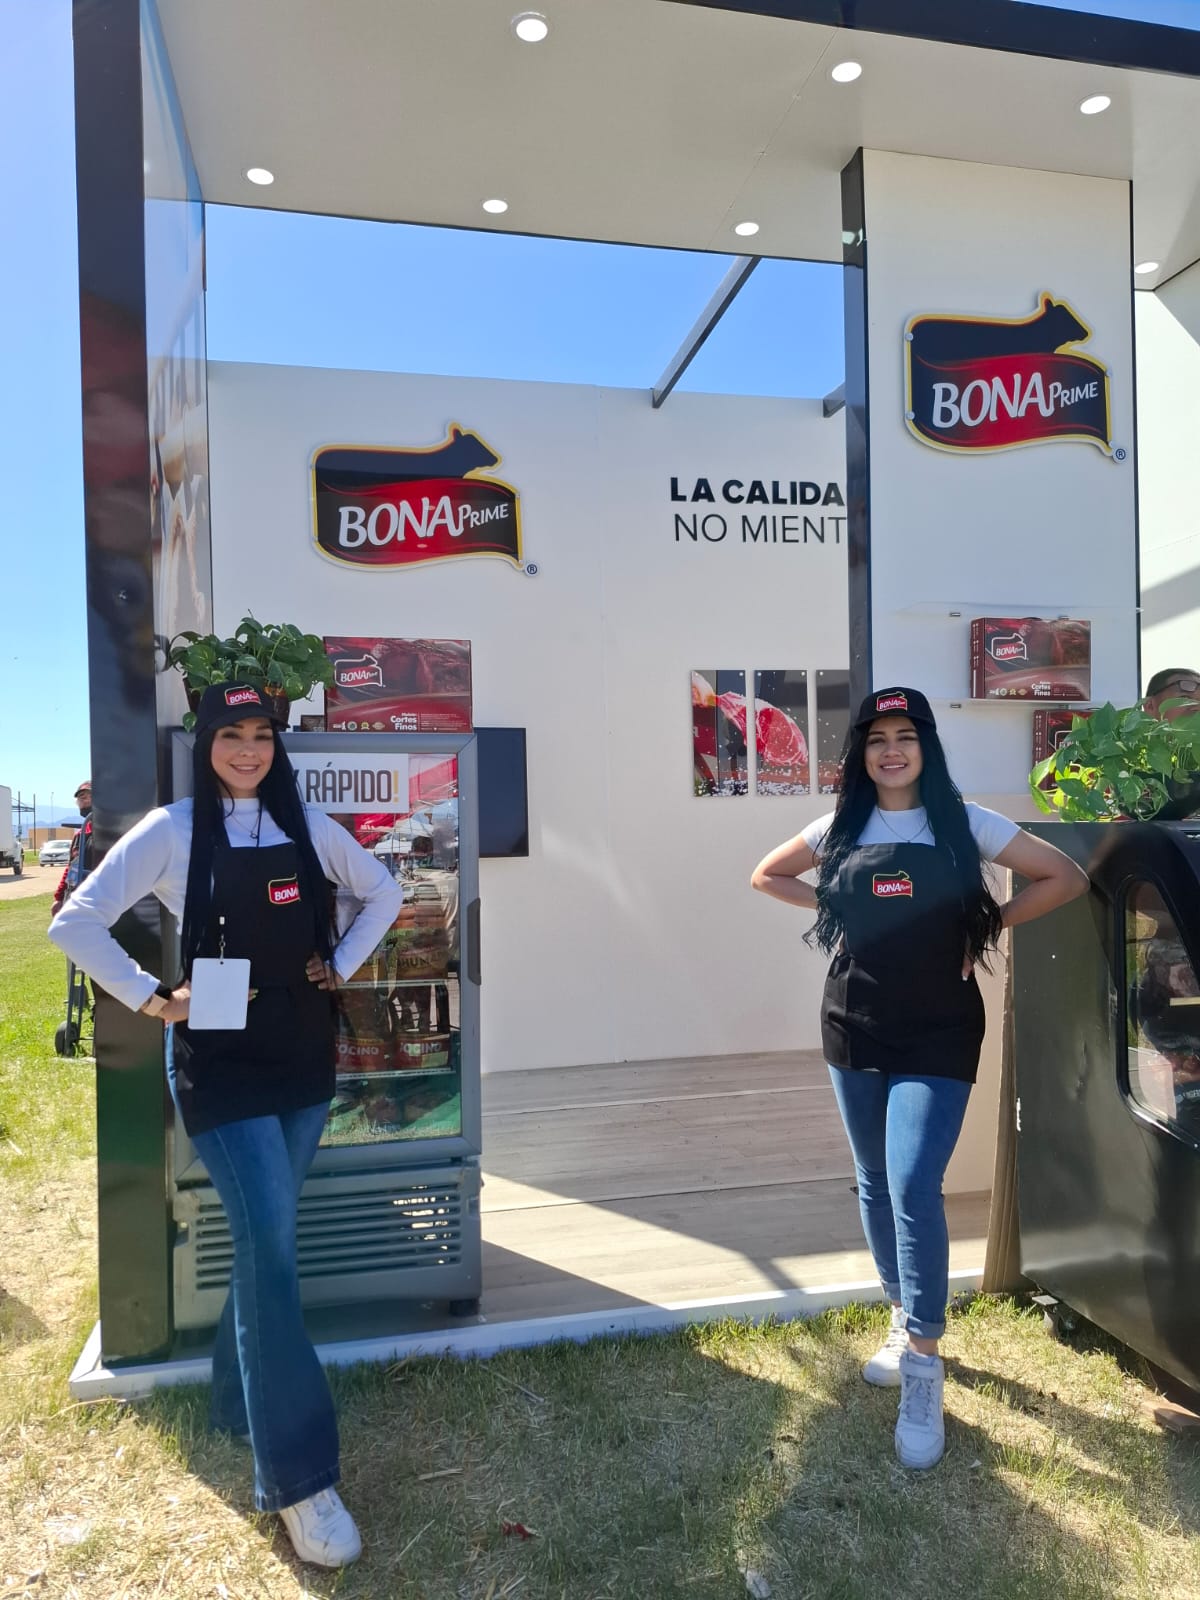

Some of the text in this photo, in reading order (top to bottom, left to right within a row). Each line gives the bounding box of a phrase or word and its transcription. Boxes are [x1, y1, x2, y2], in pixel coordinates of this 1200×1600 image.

[932, 372, 1055, 428] BONA
[670, 477, 845, 506] LA CALIDA
[338, 496, 464, 548] BONA
[674, 513, 847, 544] NO MIENT
[995, 645, 1017, 657] BONA
[340, 670, 369, 683] BONA
[229, 692, 252, 704] BONA
[879, 699, 899, 710] BONA
[390, 715, 418, 724] Cortes
[395, 723, 418, 732] Finos
[305, 761, 399, 804] RÁPIDO!
[877, 882, 902, 894] BONA
[336, 1043, 380, 1056] OCINO
